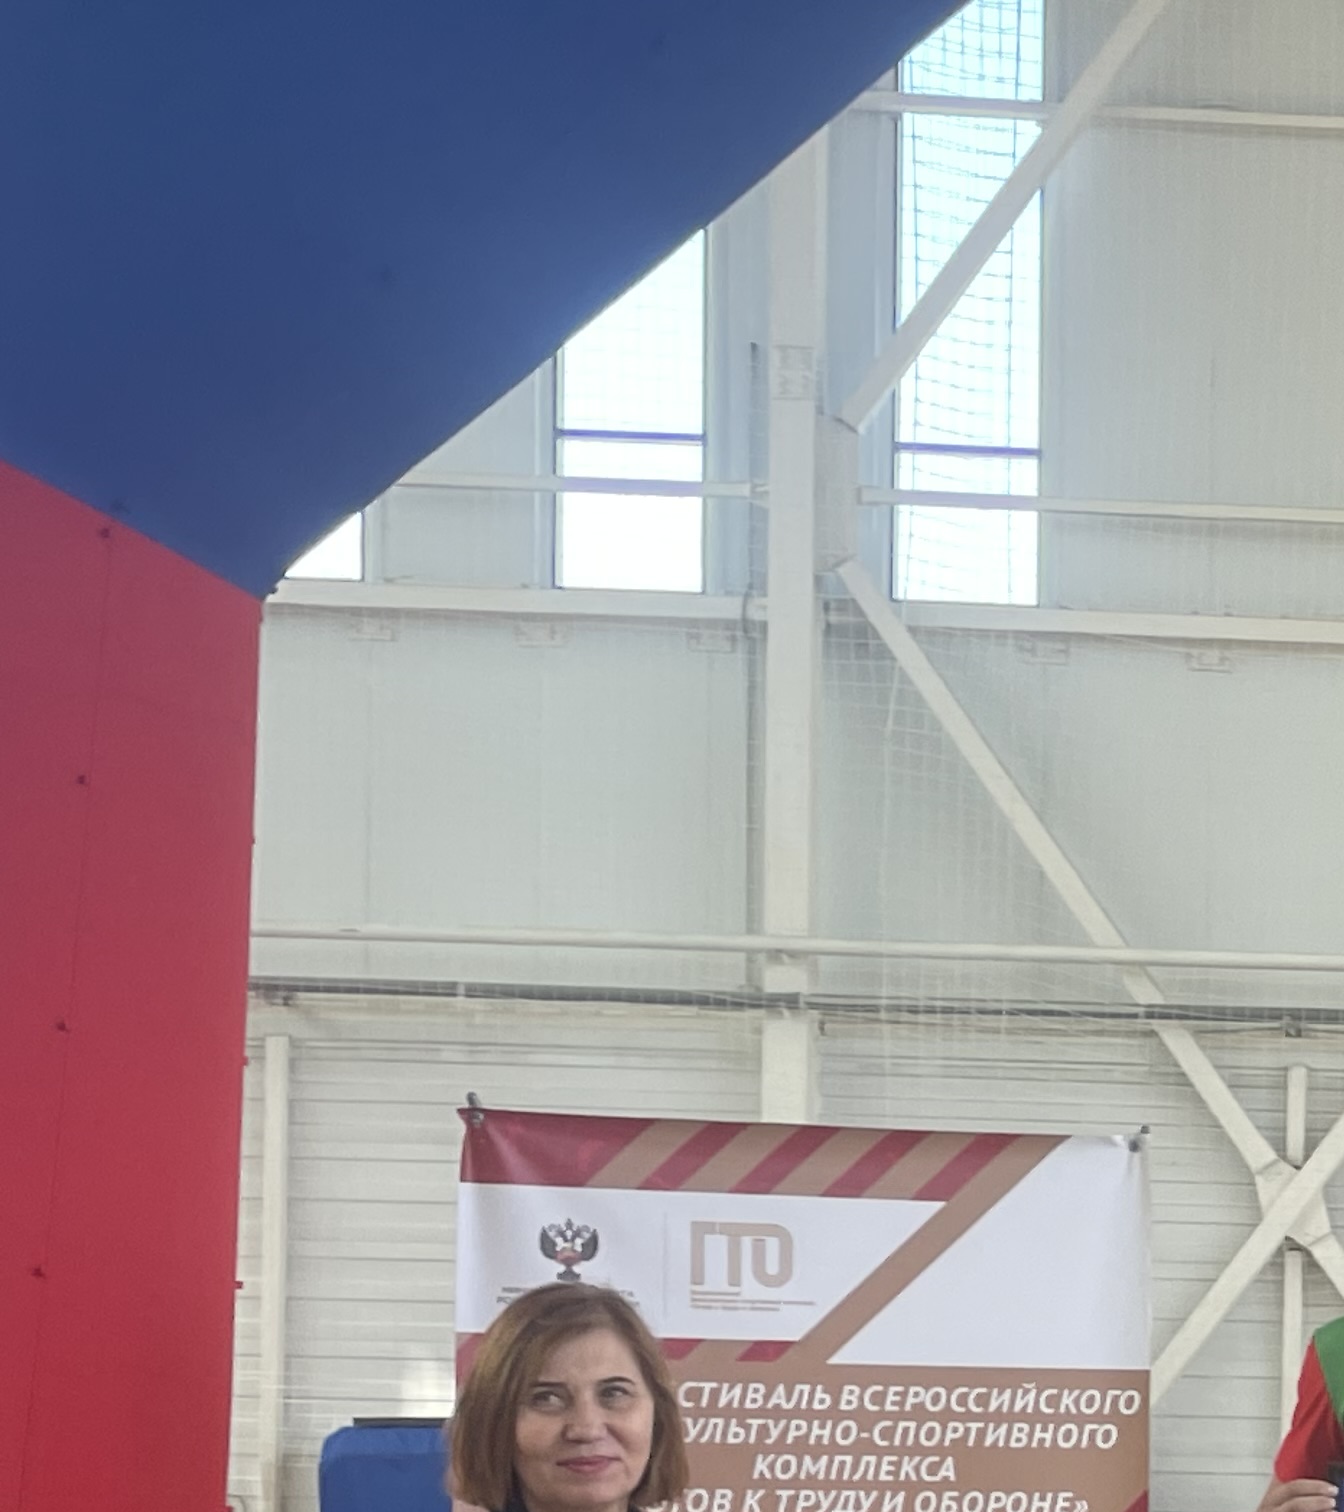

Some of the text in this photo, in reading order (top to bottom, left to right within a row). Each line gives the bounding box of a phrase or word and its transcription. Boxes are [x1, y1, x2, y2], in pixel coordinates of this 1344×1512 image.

[690, 1220, 793, 1288] ГТО
[678, 1381, 1142, 1415] СТИВАЛЬ ВСЕРОССИЙСКОГО
[683, 1416, 1120, 1449] УЛЬТУРНО-СПОРТИВНОГО
[752, 1453, 957, 1482] КОМПЛЕКСА
